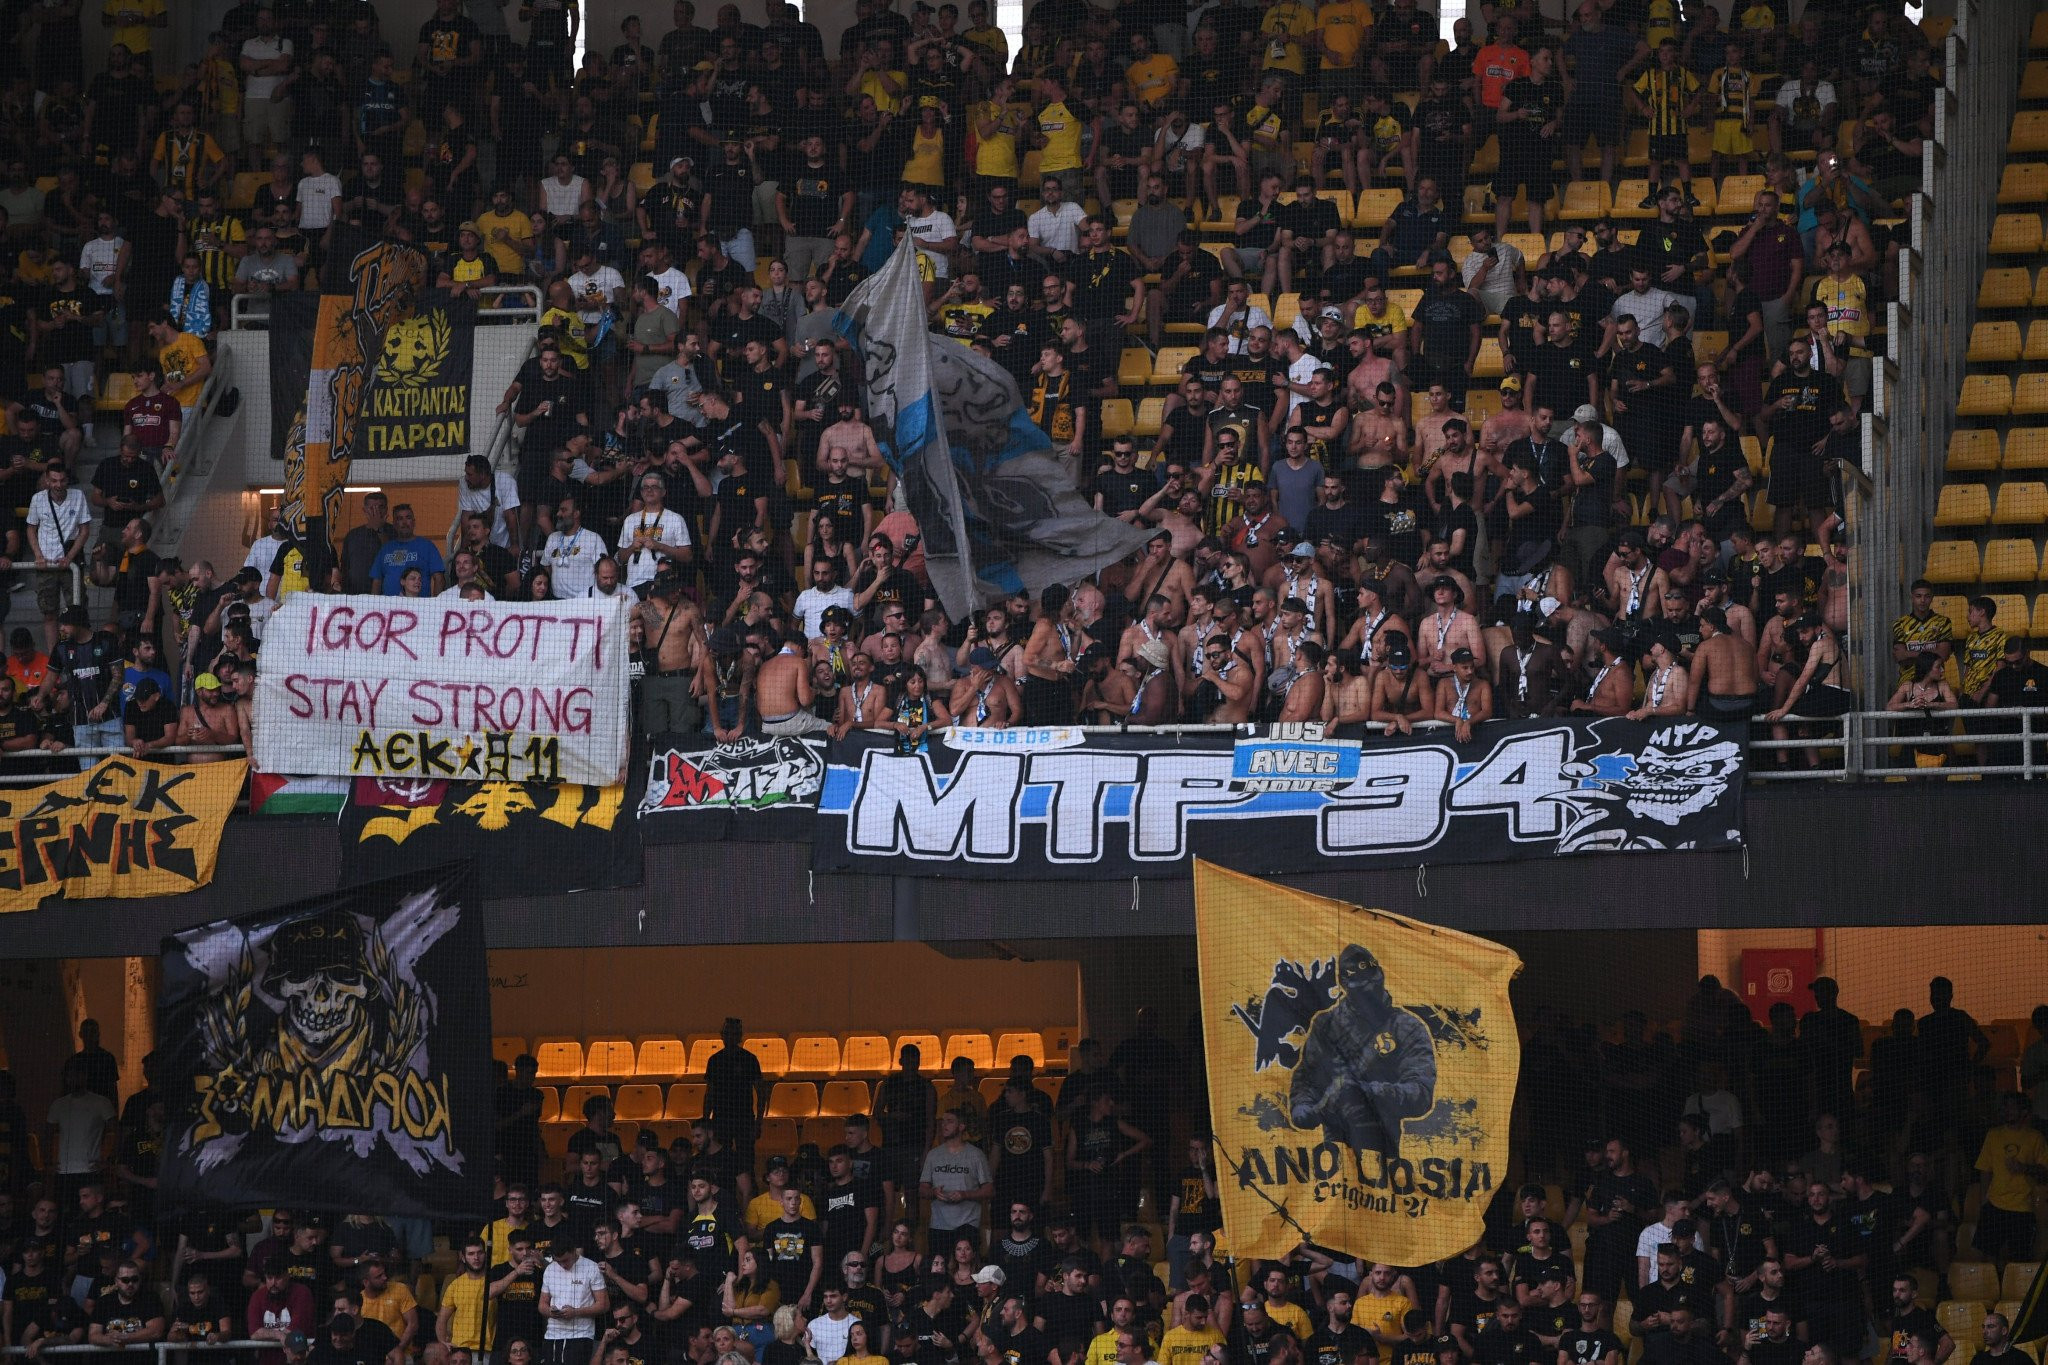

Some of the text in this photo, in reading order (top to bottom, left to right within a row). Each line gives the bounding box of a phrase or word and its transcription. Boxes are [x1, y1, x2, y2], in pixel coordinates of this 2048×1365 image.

[368, 420, 465, 451] ΠΑΡΩΝ
[306, 605, 603, 670] IGOR PROTTI
[284, 673, 594, 734] STAY STRONG
[1650, 723, 1719, 747] MTP
[1250, 750, 1338, 774] AVEC
[847, 726, 1575, 863] MTP 94
[1243, 779, 1335, 793] NOUS
[934, 1163, 971, 1175] adidas
[1238, 1141, 1341, 1190] ANO
[1313, 1178, 1397, 1214] Original
